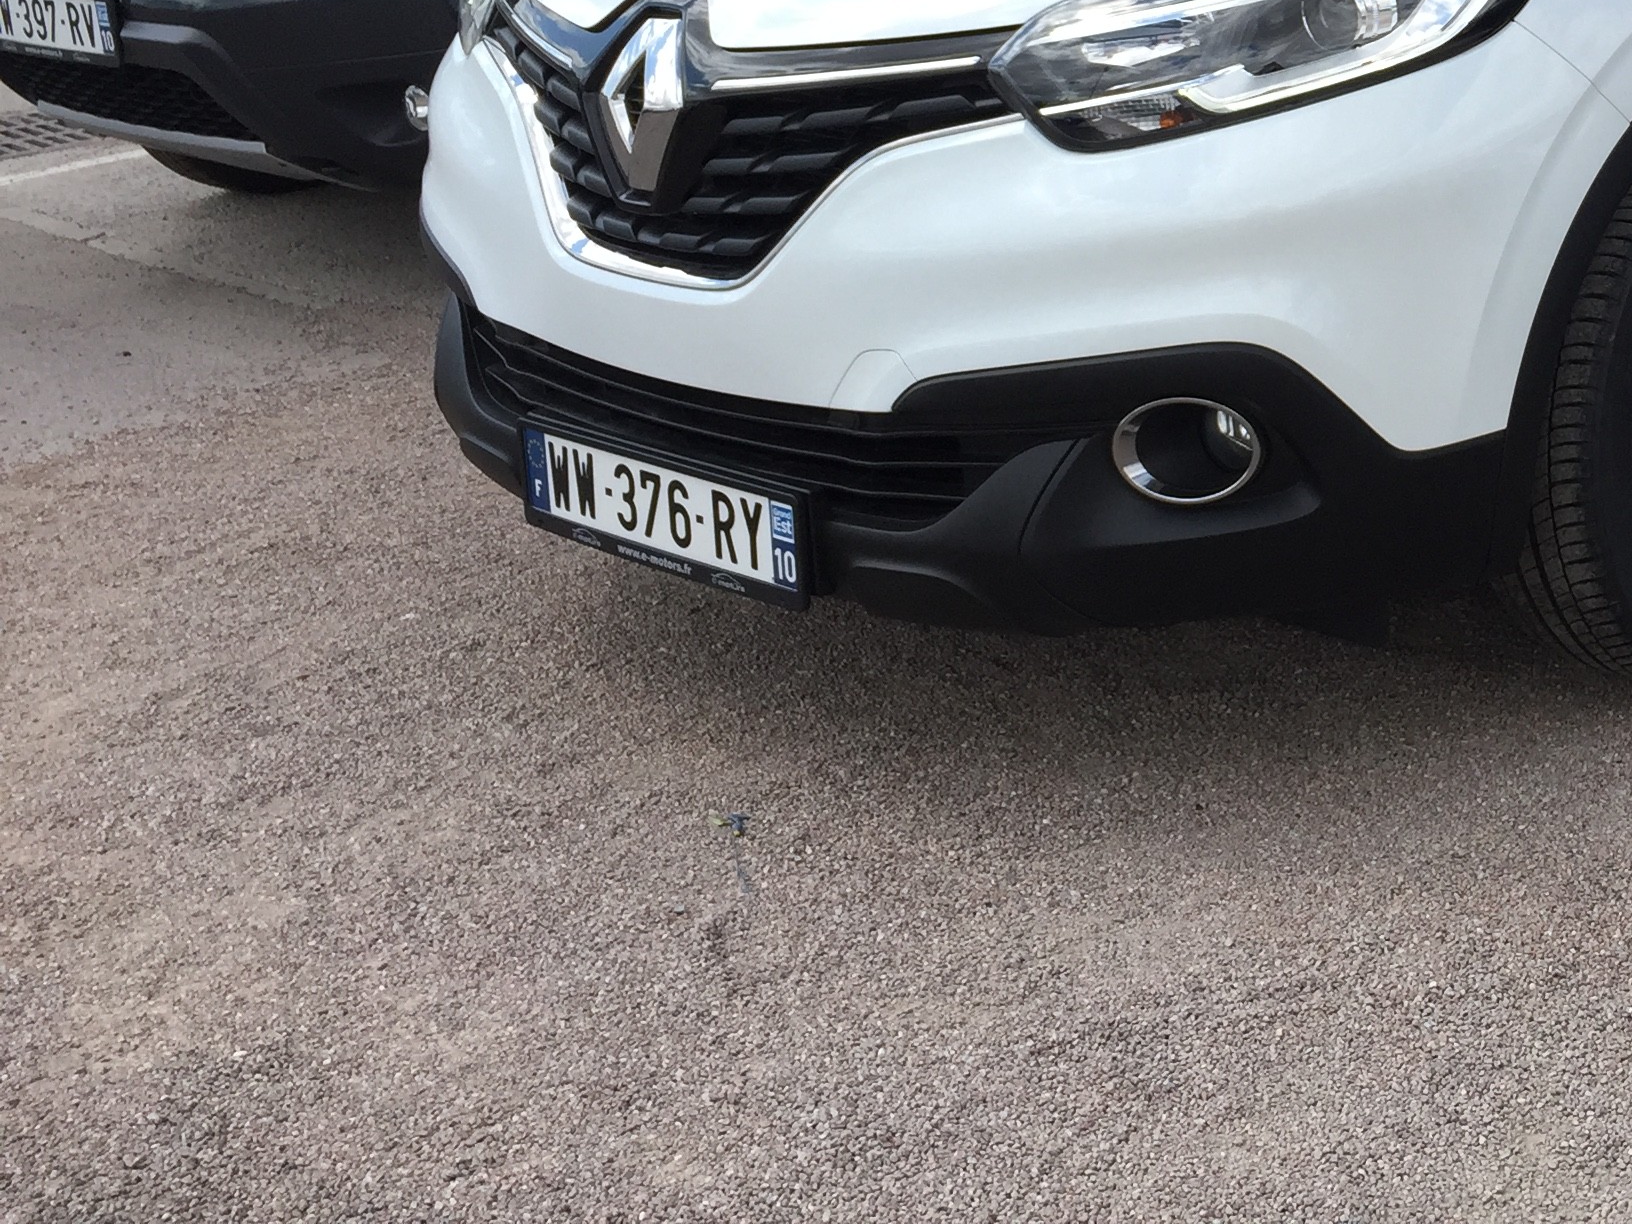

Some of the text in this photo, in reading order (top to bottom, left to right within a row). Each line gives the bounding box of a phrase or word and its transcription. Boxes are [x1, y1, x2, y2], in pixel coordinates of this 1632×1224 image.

[535, 478, 543, 498] F
[548, 441, 763, 571] WW-376-RY
[616, 544, 693, 576] www.e-motors.fr
[774, 547, 797, 583] 10
